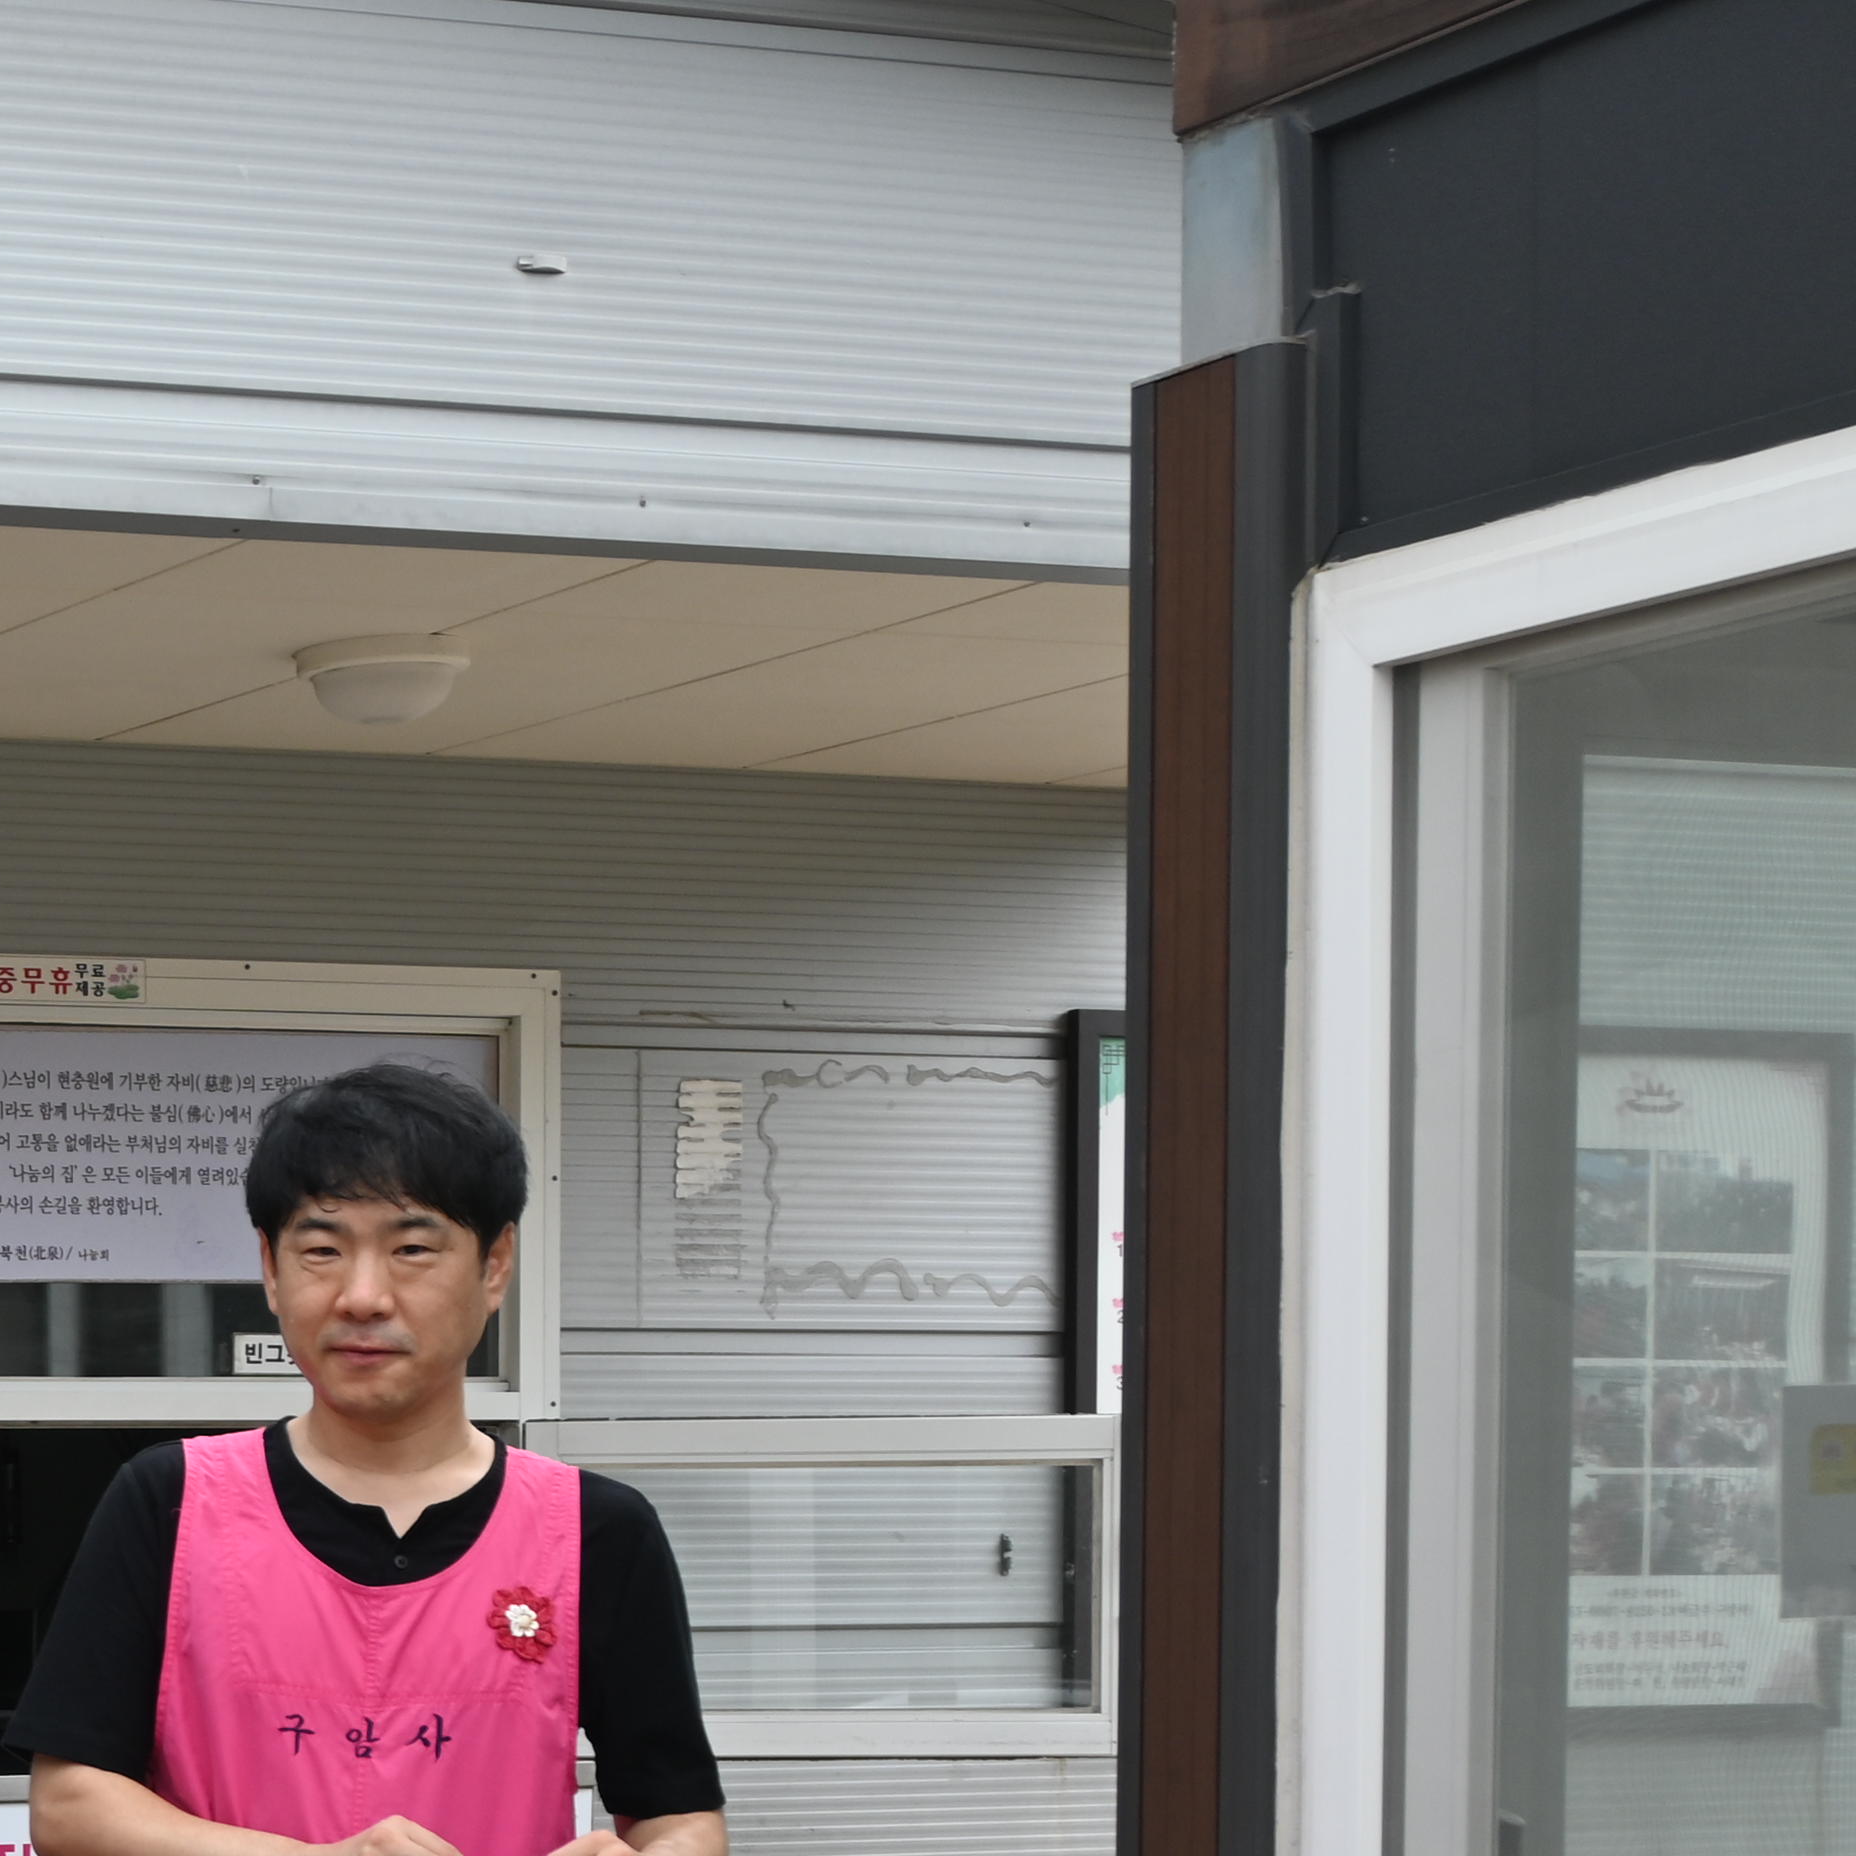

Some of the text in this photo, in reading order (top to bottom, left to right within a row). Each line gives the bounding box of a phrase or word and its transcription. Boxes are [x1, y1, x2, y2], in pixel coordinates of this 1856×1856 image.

[75, 963, 106, 979] 무료
[75, 980, 106, 997] 제공
[57, 1071, 113, 1090] 현충원에
[120, 1072, 162, 1091] 기부한
[39, 1102, 67, 1121] 함께
[73, 1102, 145, 1122] 나누겠다는
[16, 1133, 60, 1152] 고통을
[64, 1133, 121, 1153] 없애라는
[126, 1135, 181, 1154] 부처님의
[187, 1136, 229, 1155] 자비를
[82, 1165, 97, 1183] 은
[102, 1166, 130, 1184] 모든
[135, 1166, 191, 1186] 이들에게
[38, 1196, 83, 1215] 손길을
[87, 1197, 162, 1216] 환영합니다.
[245, 1342, 295, 1365] 빈그
